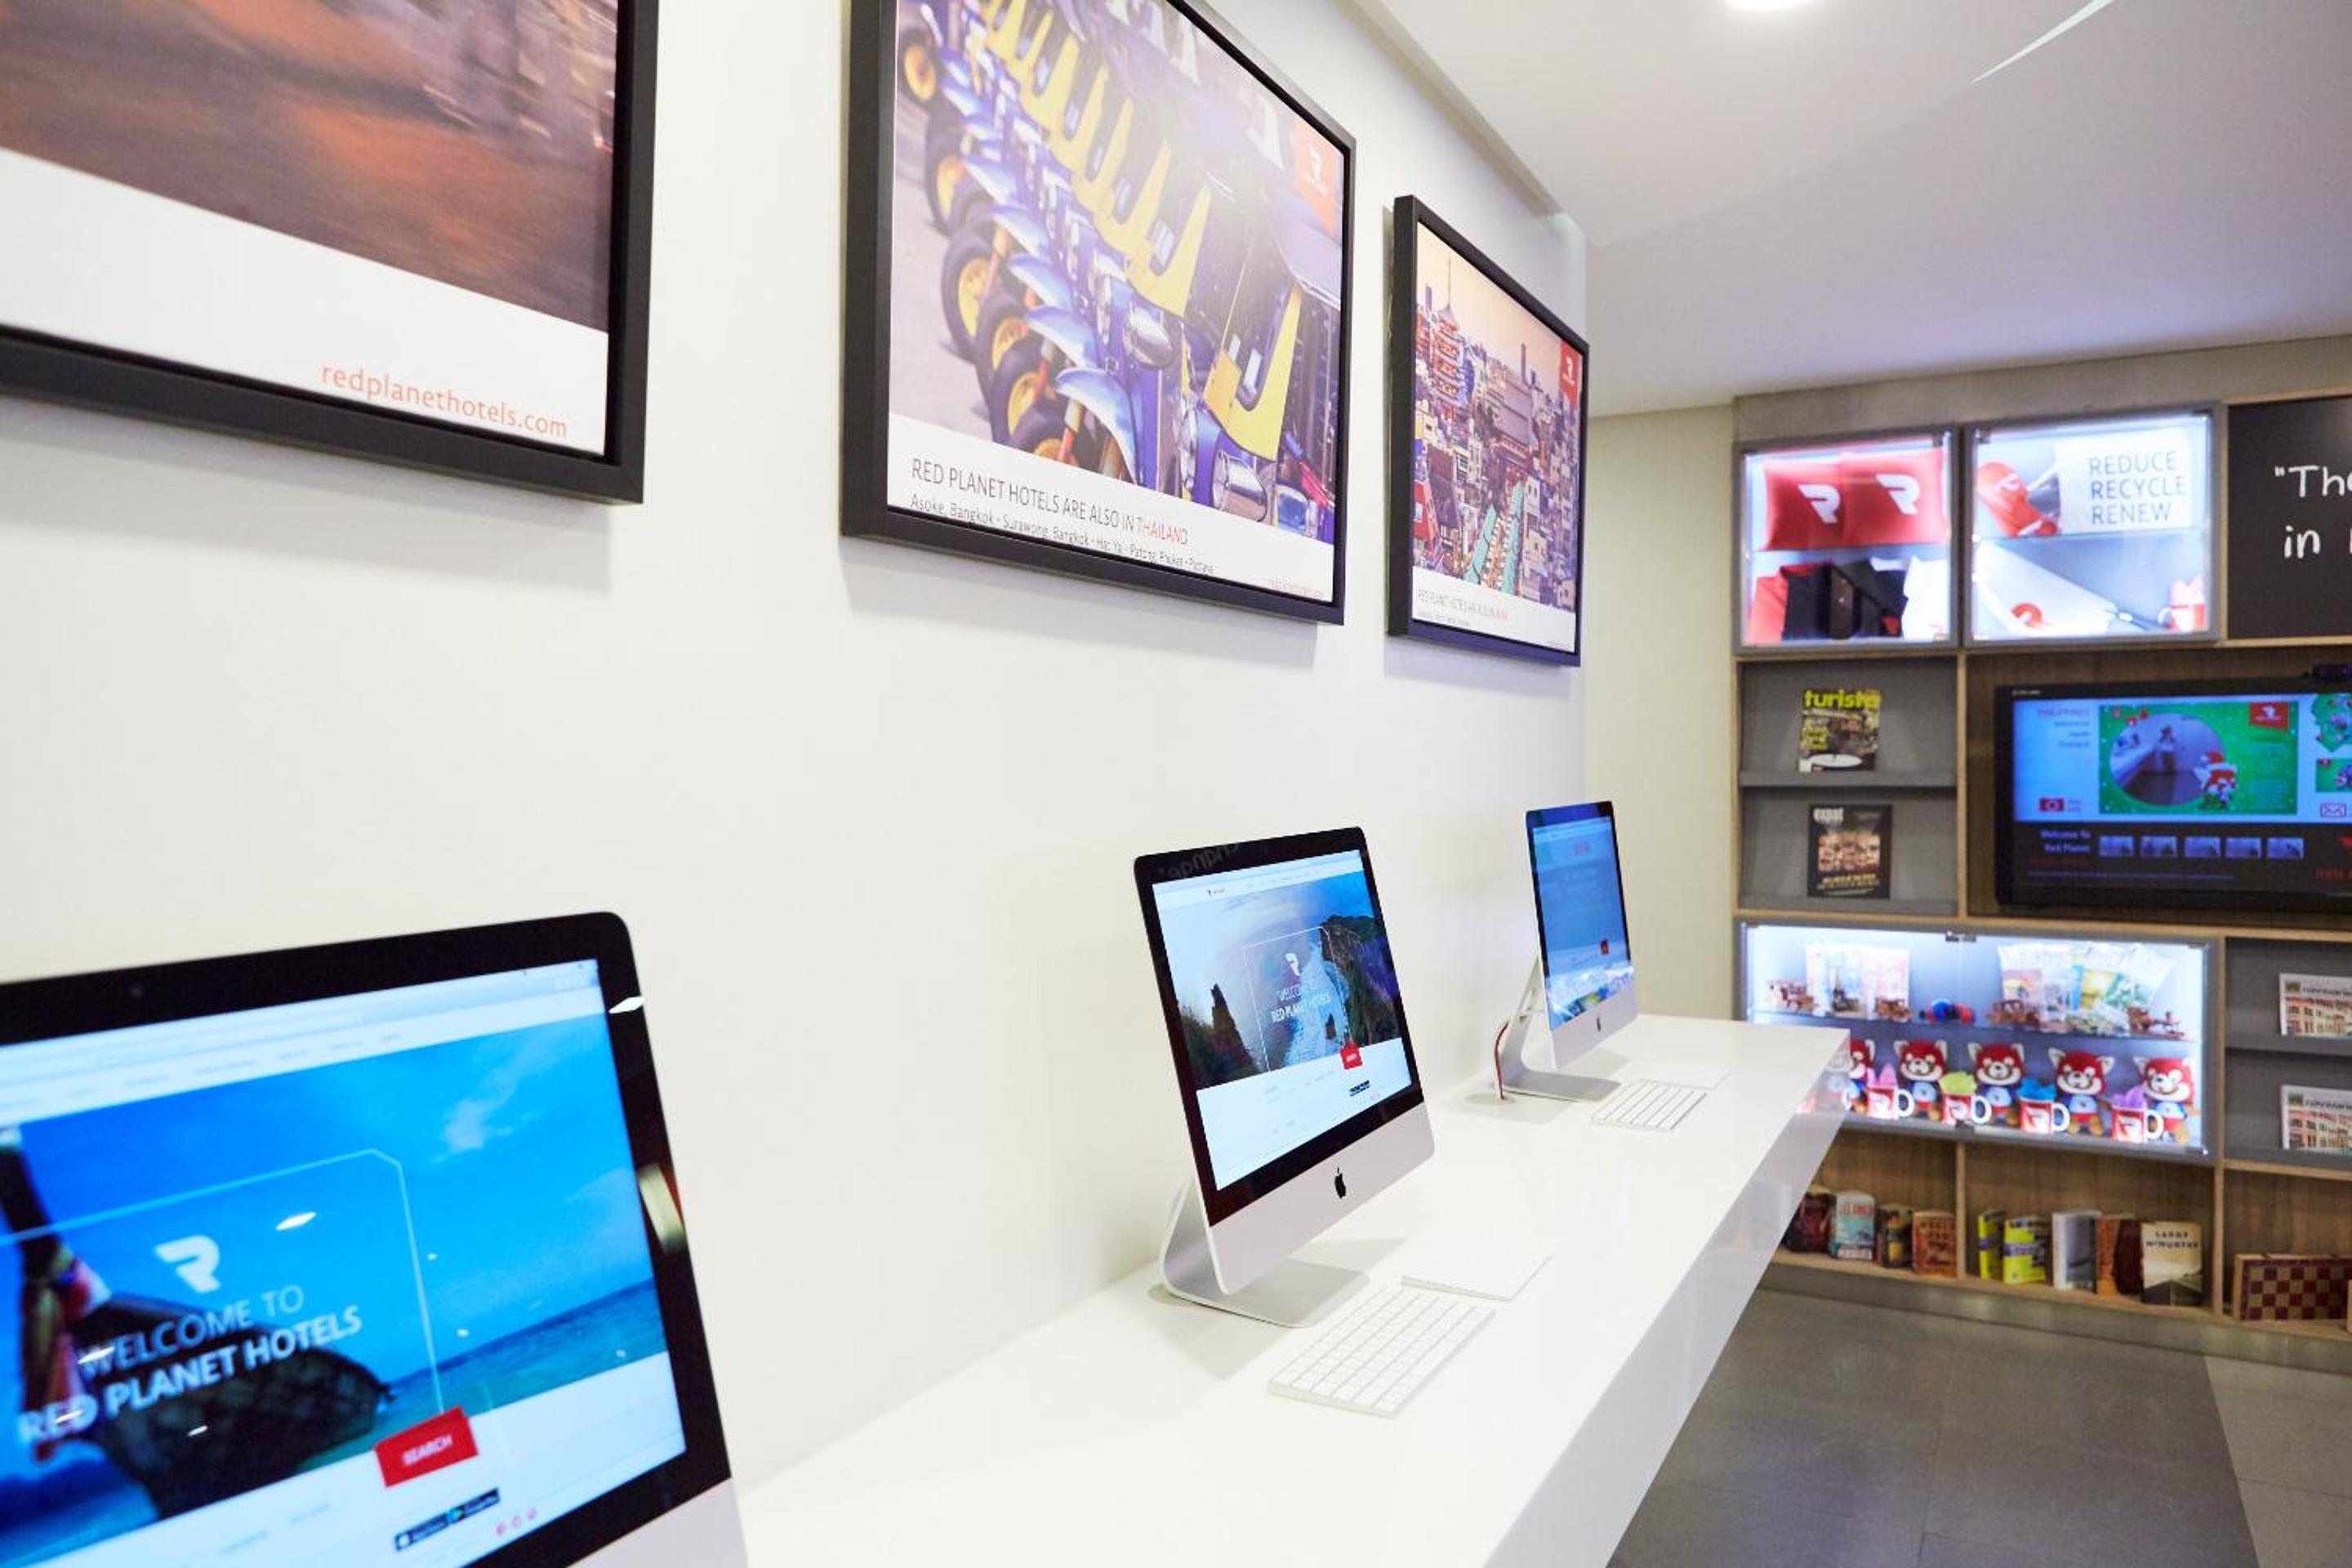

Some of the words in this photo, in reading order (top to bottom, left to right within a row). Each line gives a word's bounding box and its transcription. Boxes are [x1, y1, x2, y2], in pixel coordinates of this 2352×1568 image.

[321, 364, 568, 439] redplanethotels.com
[2089, 451, 2176, 475] REDUCE
[911, 458, 945, 484] RED
[949, 466, 1005, 499] PLANET
[1009, 483, 1059, 514] HOTELS
[1062, 497, 1086, 520] ARE
[1089, 504, 1120, 528] ALSO
[1122, 514, 1135, 532] IN
[1137, 516, 1189, 546] THAILAND
[2091, 476, 2187, 500] RECYCLE
[951, 501, 994, 523] Bangkok
[2091, 502, 2171, 525] RENEW
[2284, 525, 2320, 559] in
[79, 1299, 253, 1379] WELCOME
[263, 1285, 305, 1318] TO
[18, 1394, 99, 1445] RED
[105, 1343, 238, 1416] PLANET
[246, 1304, 363, 1370] HOTELS
